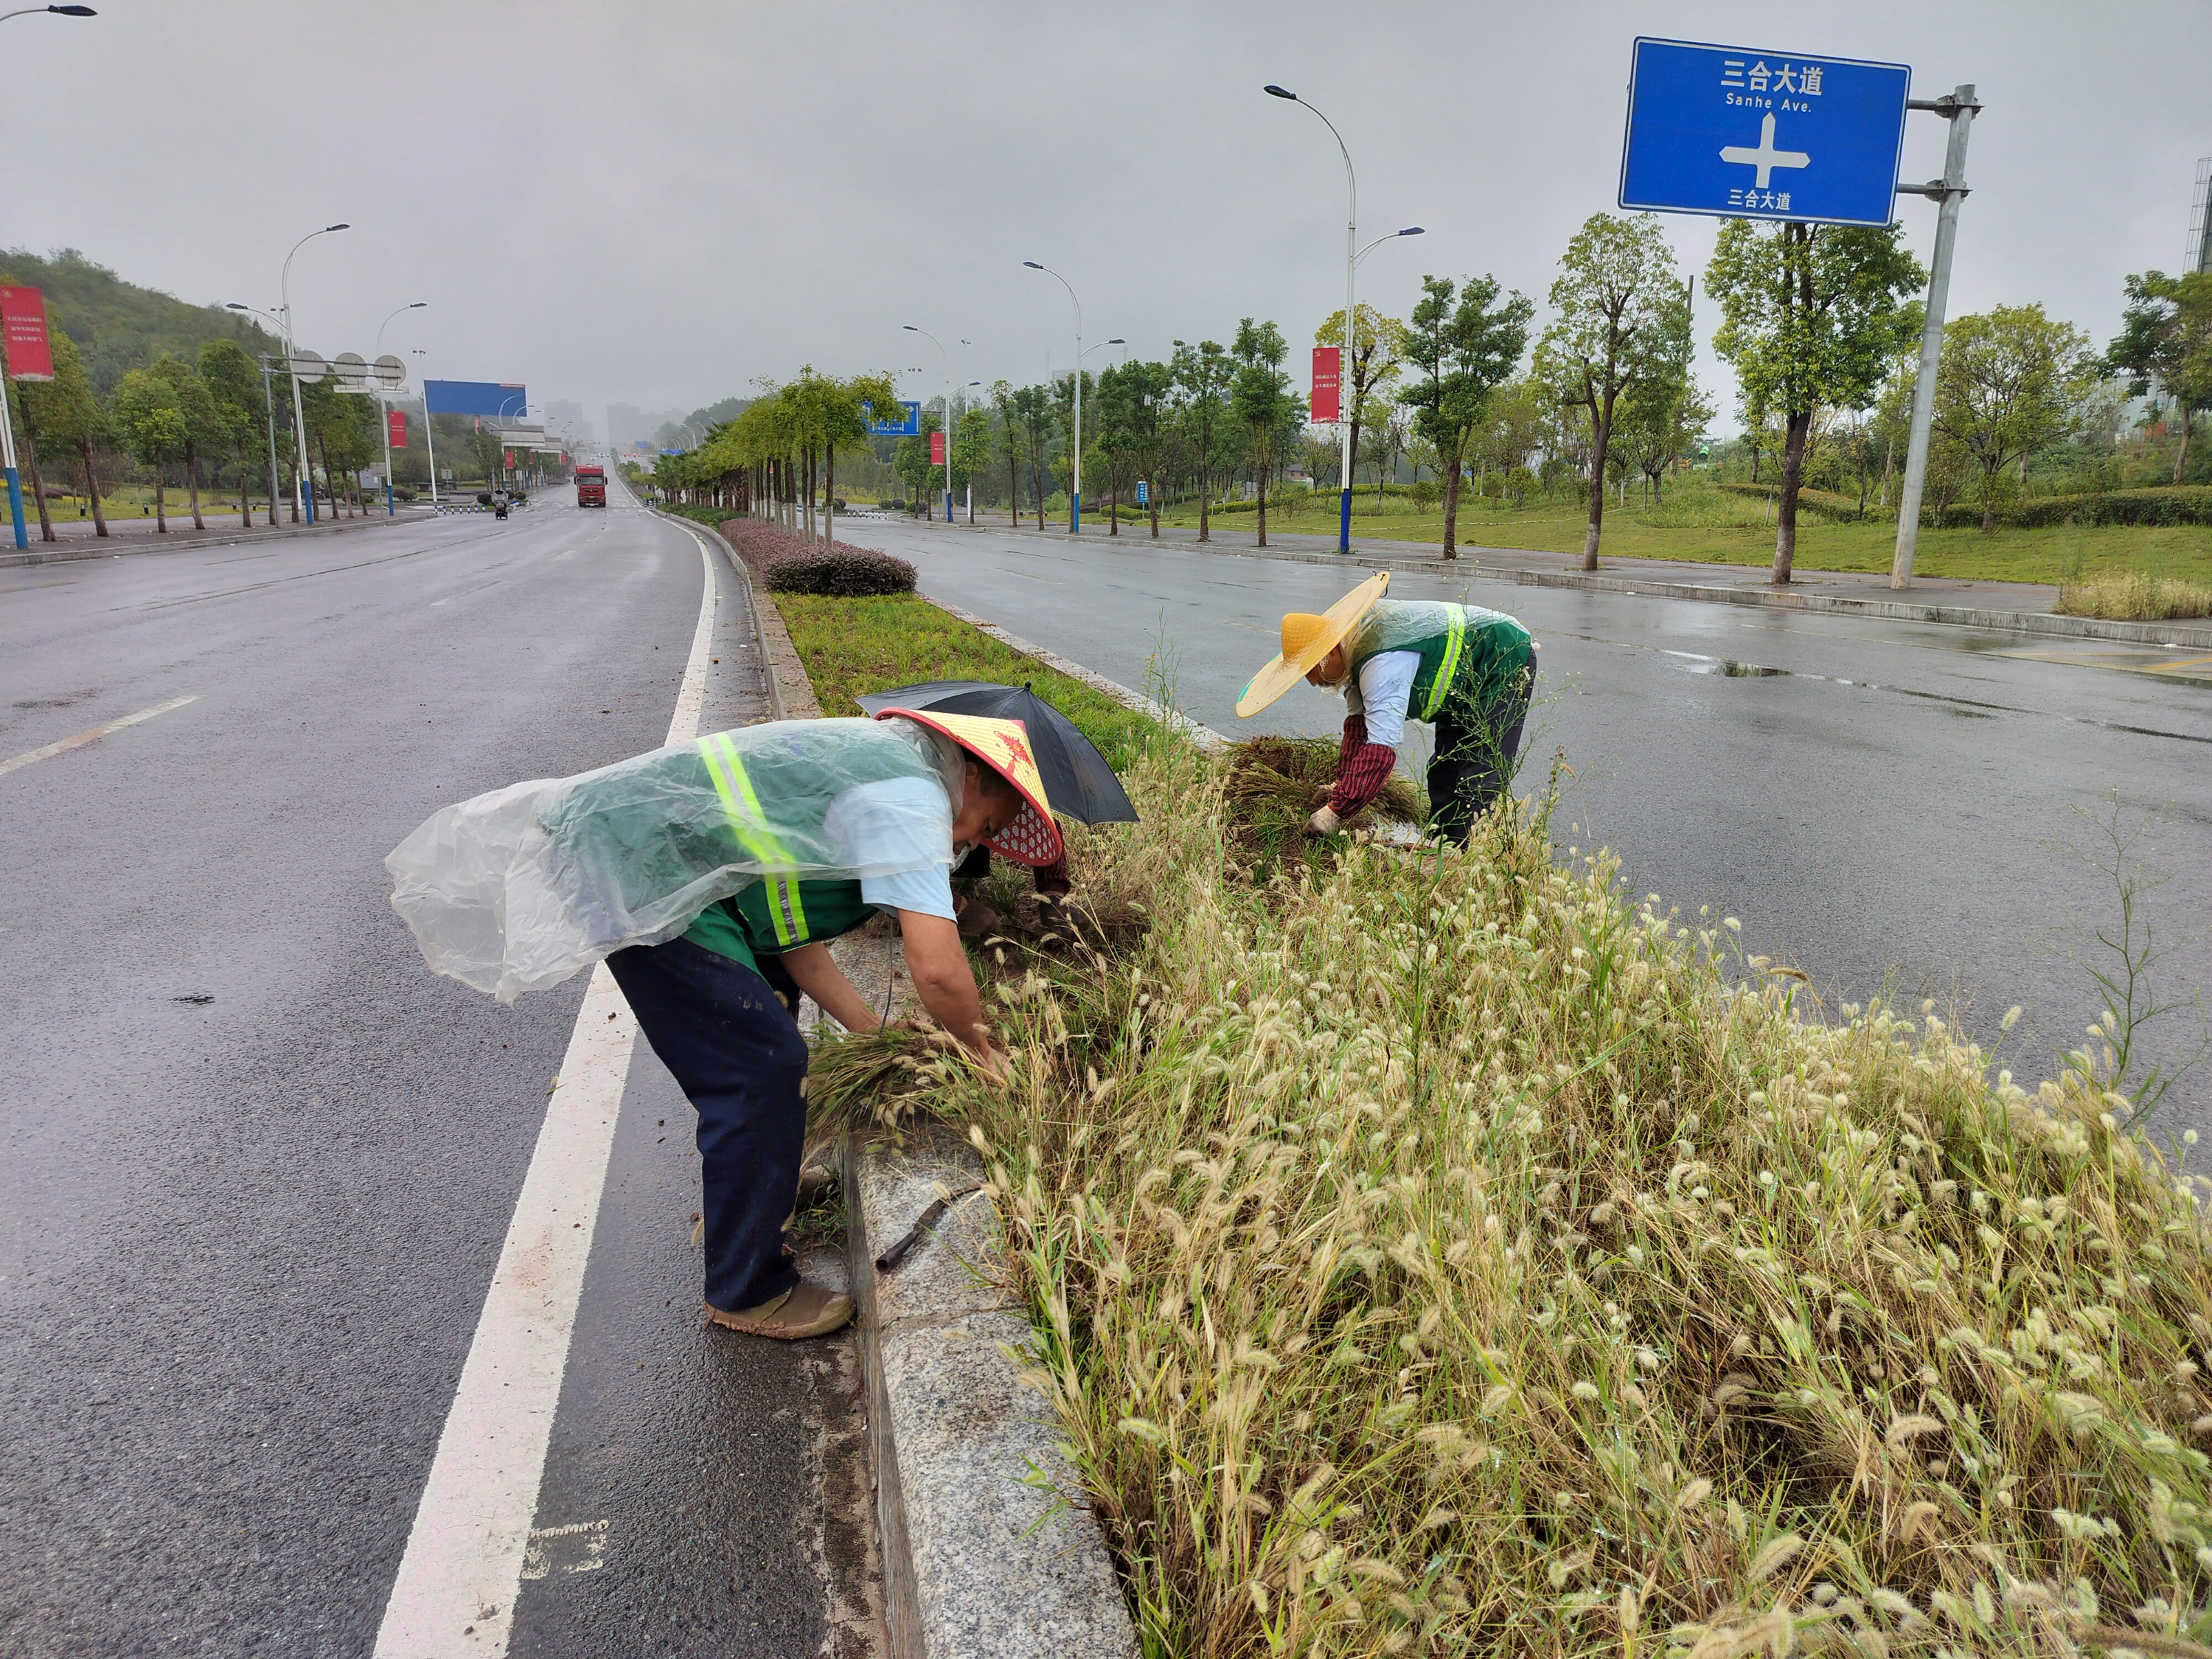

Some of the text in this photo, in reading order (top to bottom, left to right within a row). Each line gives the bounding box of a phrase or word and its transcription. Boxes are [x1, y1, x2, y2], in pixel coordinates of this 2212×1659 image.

[1720, 60, 1823, 96] 三合大道
[1725, 92, 1812, 113] Sanhe Ave.
[1727, 189, 1791, 211] 三合大道
